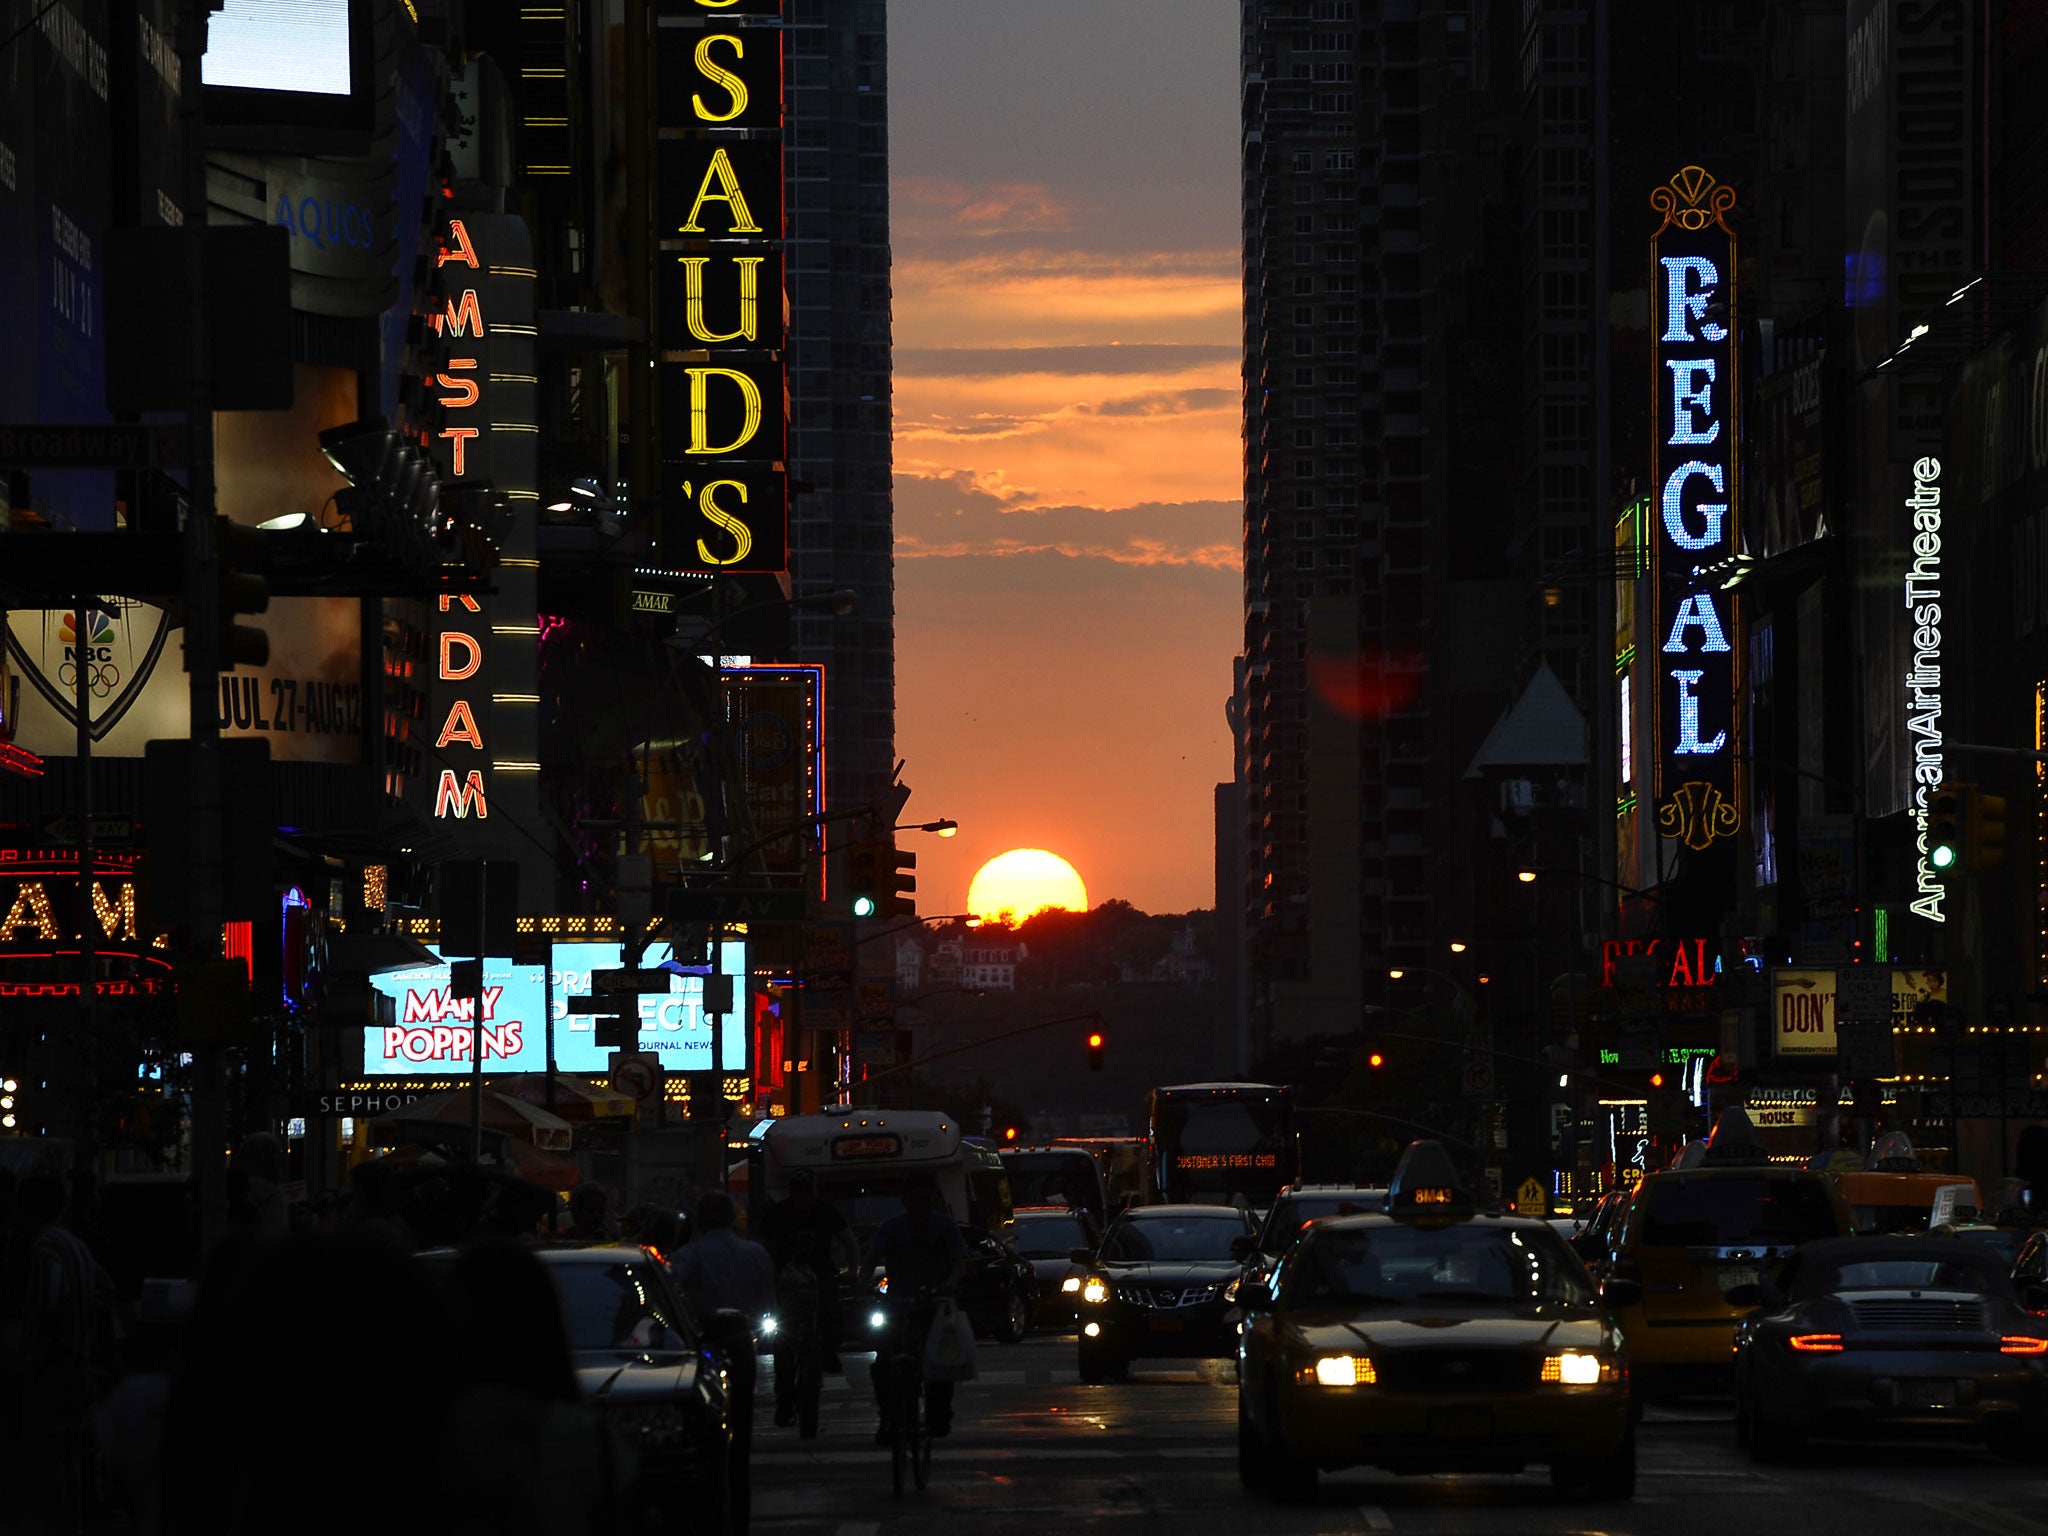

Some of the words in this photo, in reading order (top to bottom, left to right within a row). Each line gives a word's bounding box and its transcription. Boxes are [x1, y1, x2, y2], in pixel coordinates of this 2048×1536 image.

[278, 193, 374, 251] AQUOS
[53, 256, 75, 325] JULY
[679, 0, 765, 565] SAUD'S
[0, 429, 139, 466] Broadway
[435, 219, 487, 820] AMSTDAM
[1660, 255, 1732, 757] REGAL
[632, 594, 669, 610] AMAR
[64, 647, 111, 661] NBC
[219, 677, 269, 731] JUL
[1801, 850, 1840, 870] New
[712, 898, 725, 915] 7
[1601, 938, 1717, 987] RAL
[603, 976, 626, 987] ONE
[638, 976, 661, 987] WAY
[403, 985, 503, 1022] MARY
[384, 1021, 522, 1061] POPPINS
[637, 1042, 681, 1050] OURNAL
[1759, 1111, 1795, 1124] HOUSE
[1229, 1154, 1253, 1168] FIRST
[1415, 1187, 1452, 1204] 8M43
